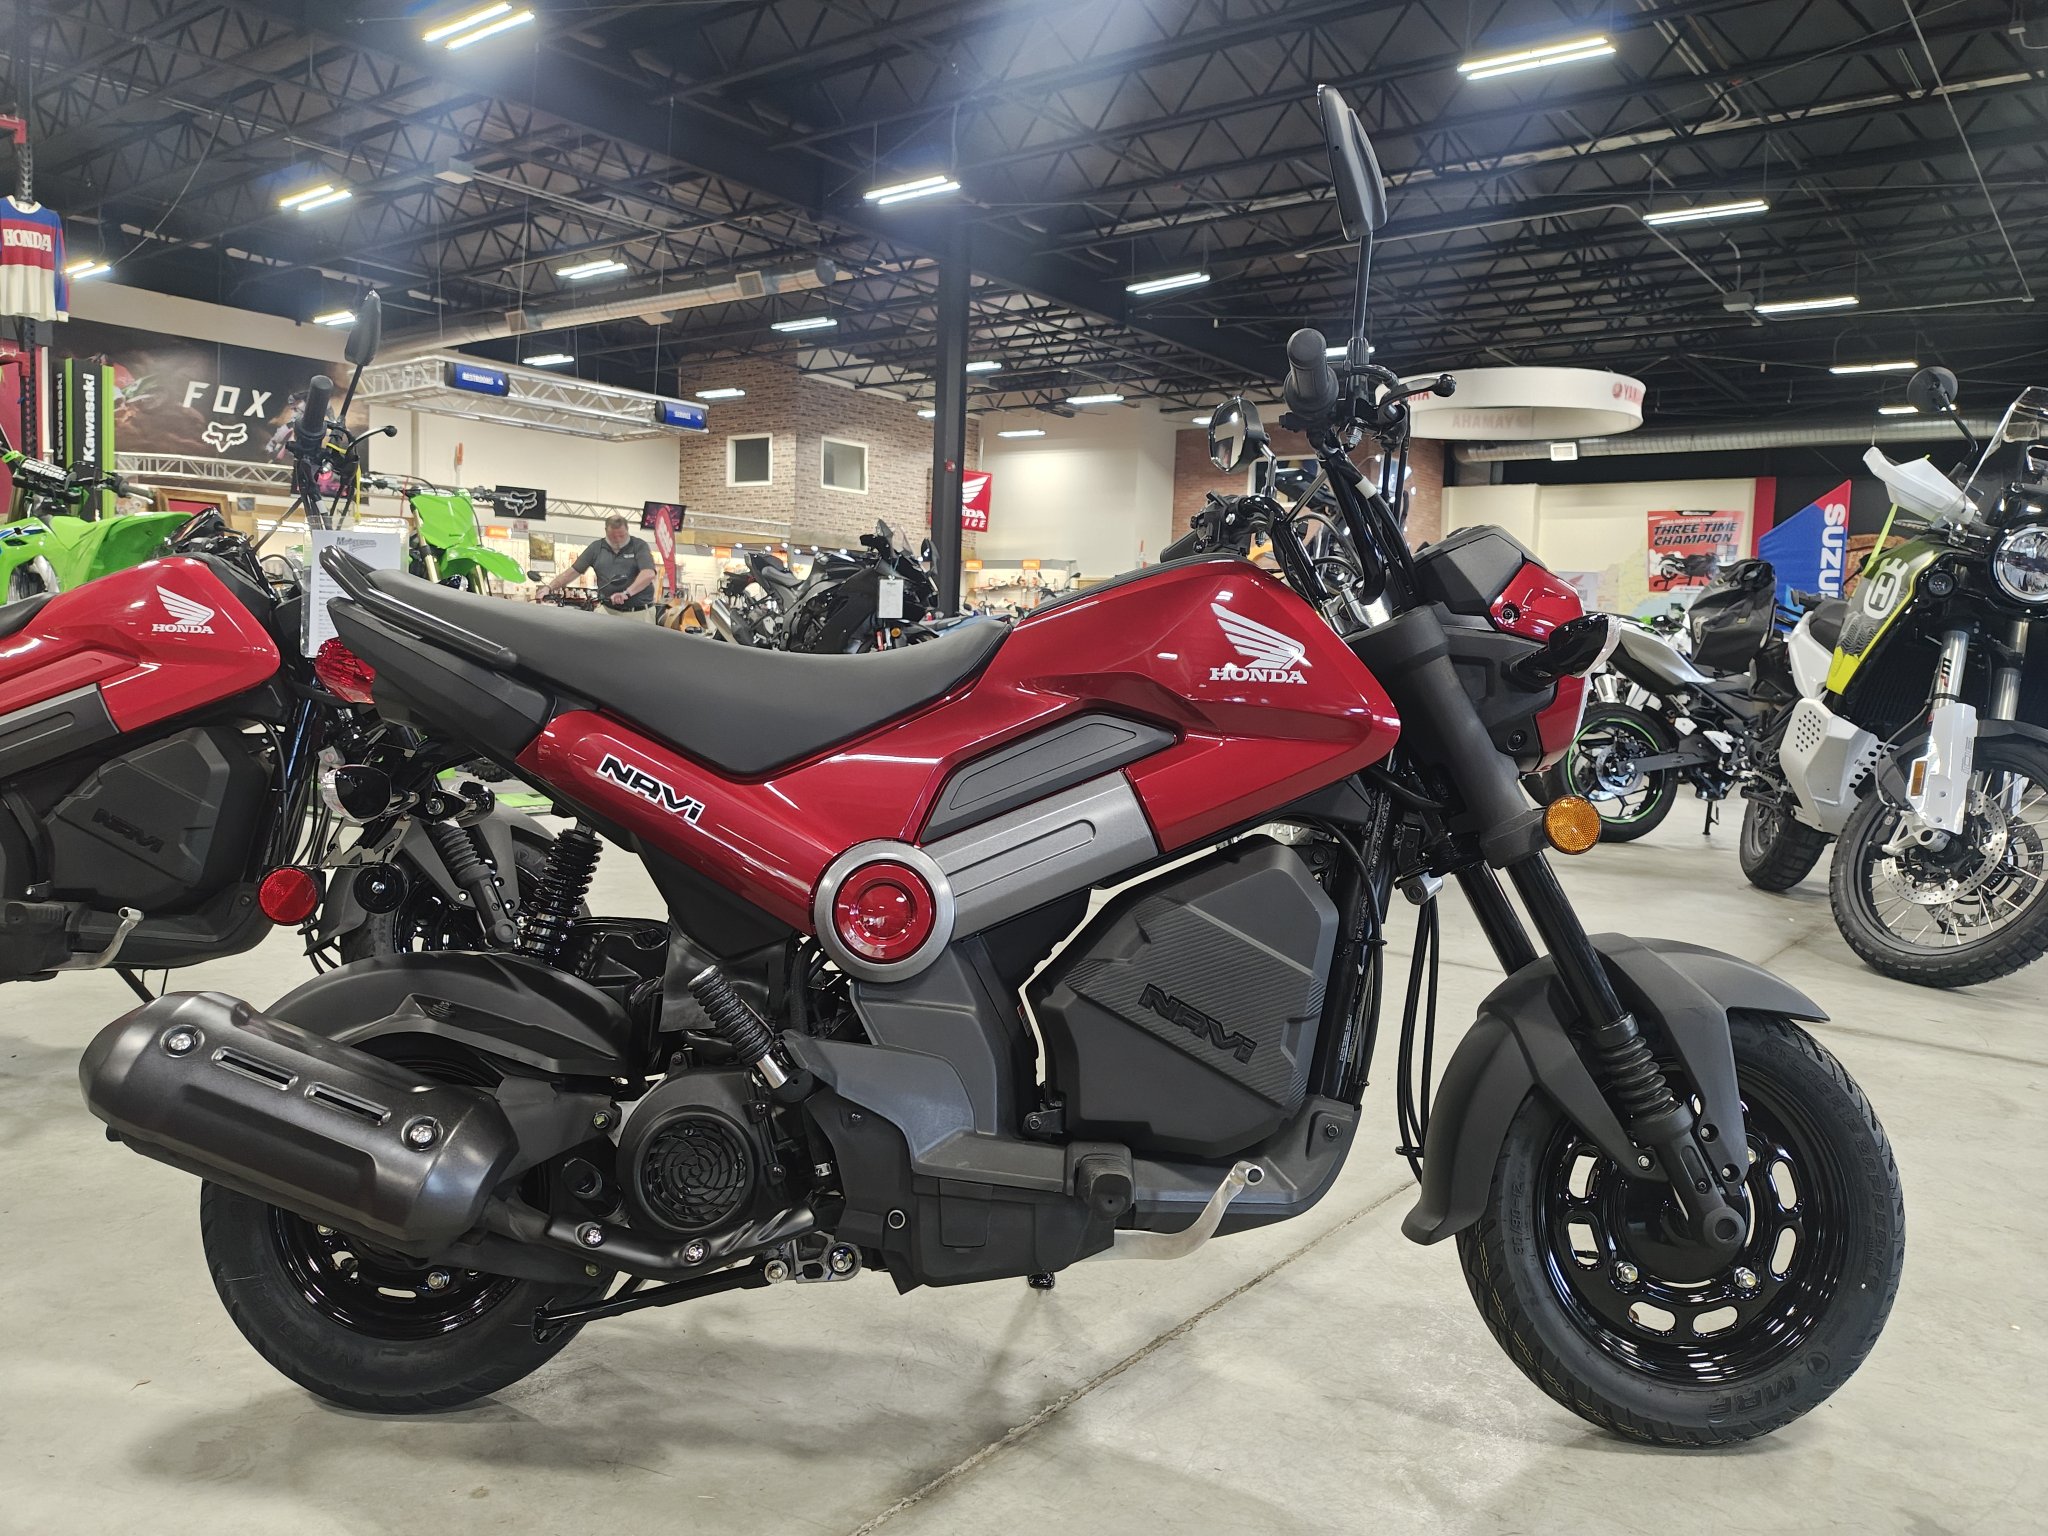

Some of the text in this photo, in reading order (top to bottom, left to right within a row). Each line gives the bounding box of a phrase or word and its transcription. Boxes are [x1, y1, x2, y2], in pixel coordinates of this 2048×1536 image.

[2, 228, 52, 252] HONDA
[182, 380, 272, 419] FOX
[83, 373, 95, 462] Kawasaki
[1654, 522, 1738, 536] THREE TIME
[1654, 533, 1733, 546] CHAMPION
[1818, 503, 1846, 598] SUZU
[152, 623, 215, 634] HONDA
[1209, 667, 1307, 684] HONDA
[1707, 1375, 1797, 1418] MRF
